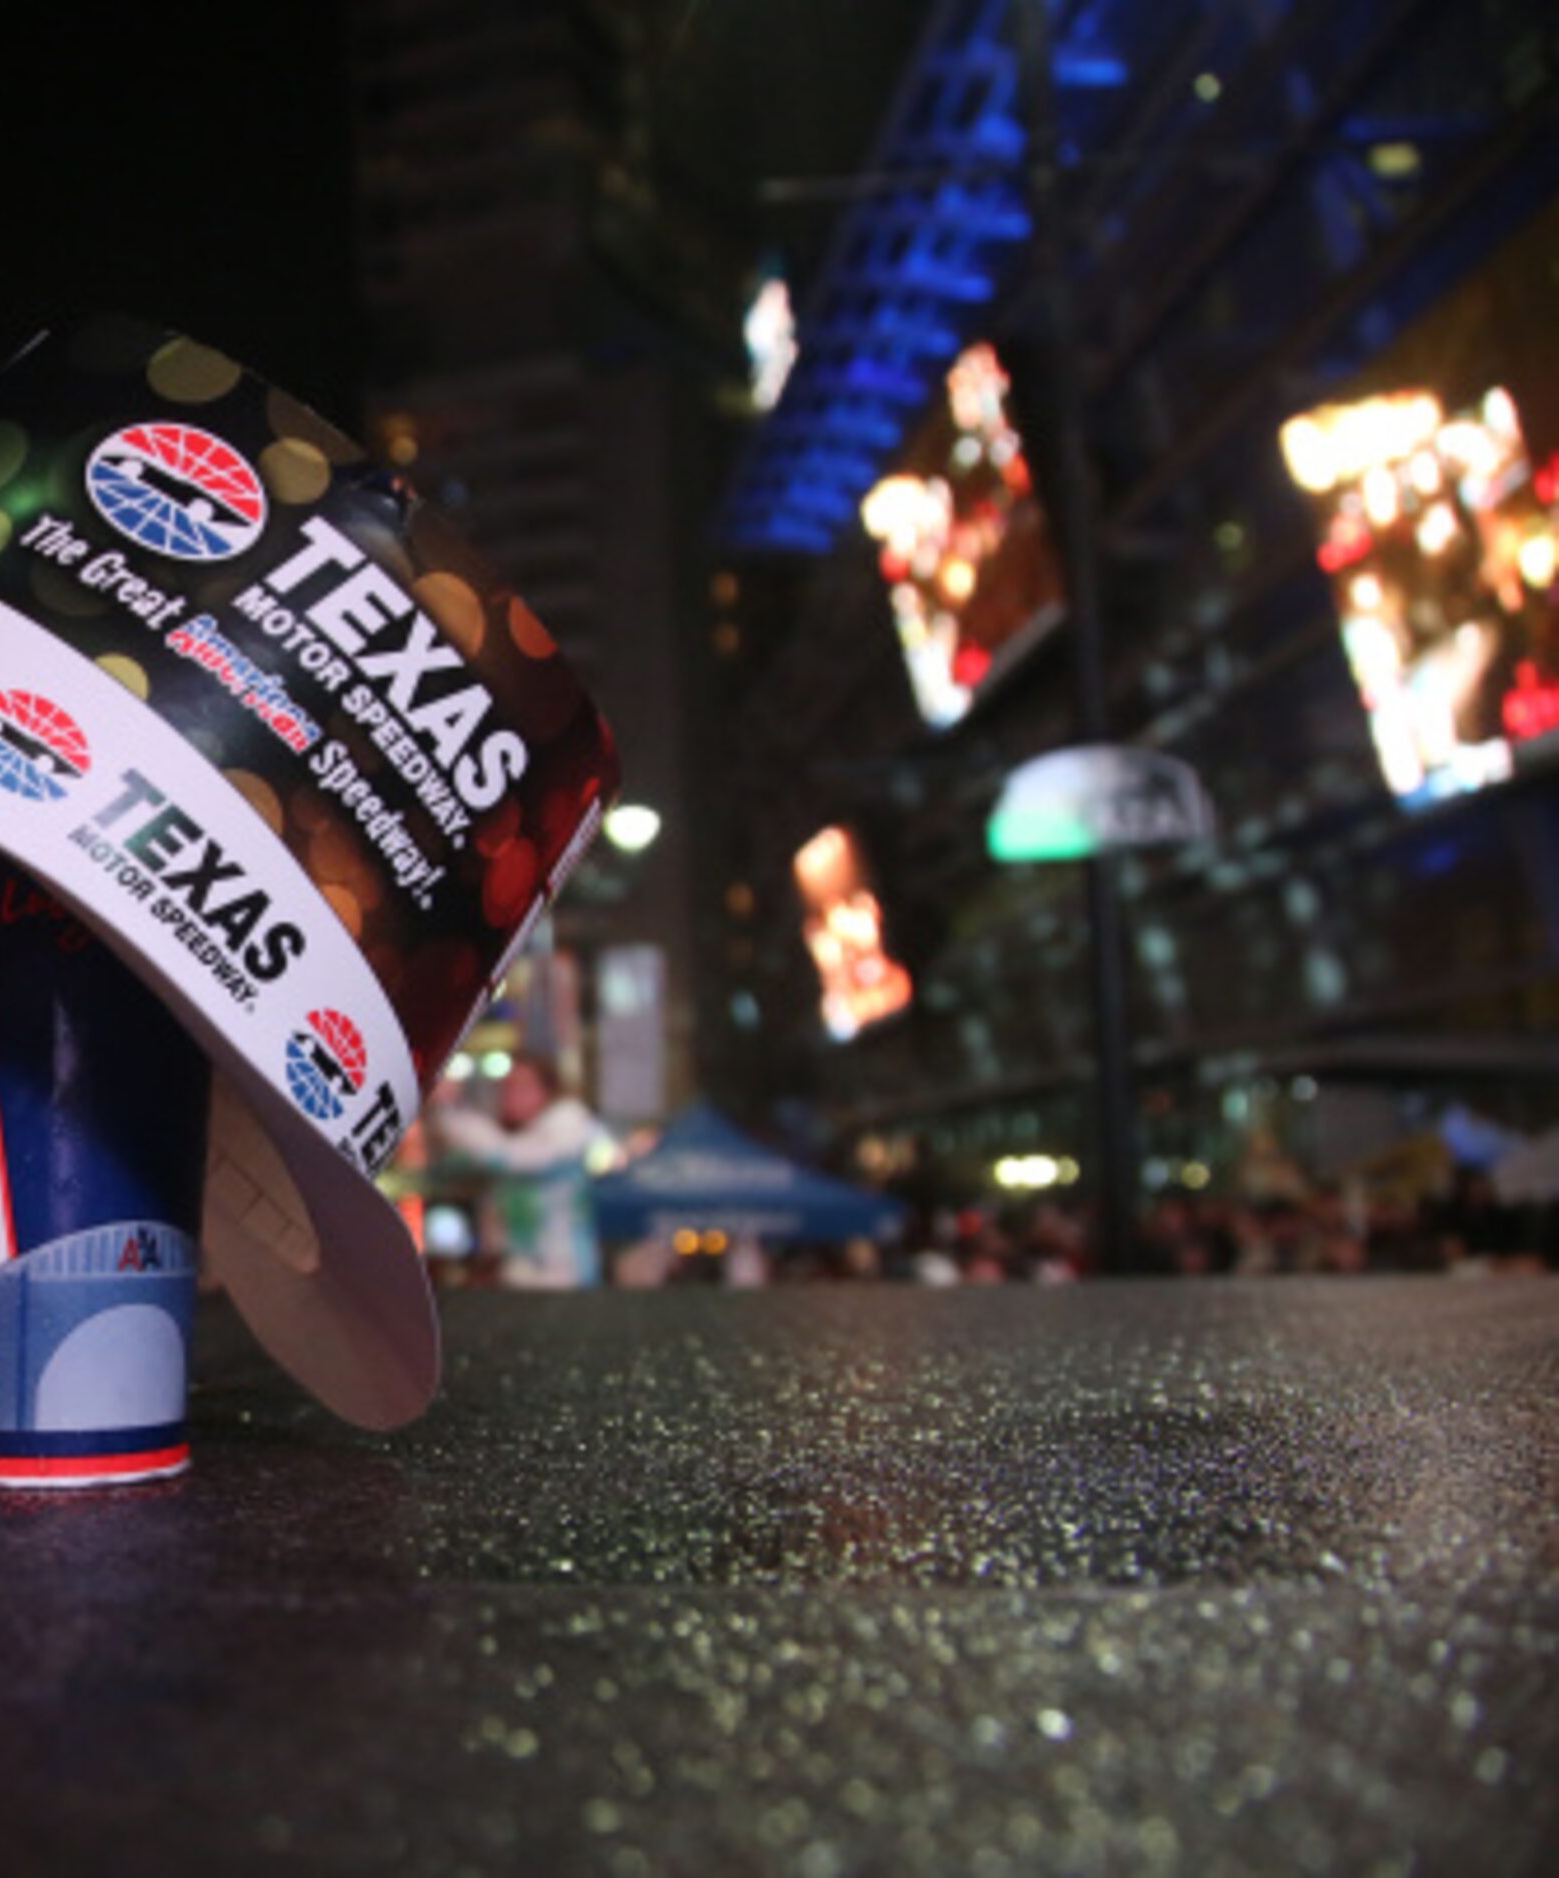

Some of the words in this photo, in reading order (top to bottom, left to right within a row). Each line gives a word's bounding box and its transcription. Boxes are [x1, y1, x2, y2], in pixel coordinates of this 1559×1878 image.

[20, 515, 89, 565] The
[79, 551, 186, 630] Great
[164, 613, 324, 754] American
[232, 584, 354, 692] MOTOR
[263, 515, 530, 810] TEXAS
[66, 823, 158, 902] MOTOR
[92, 767, 307, 983] TEXAS
